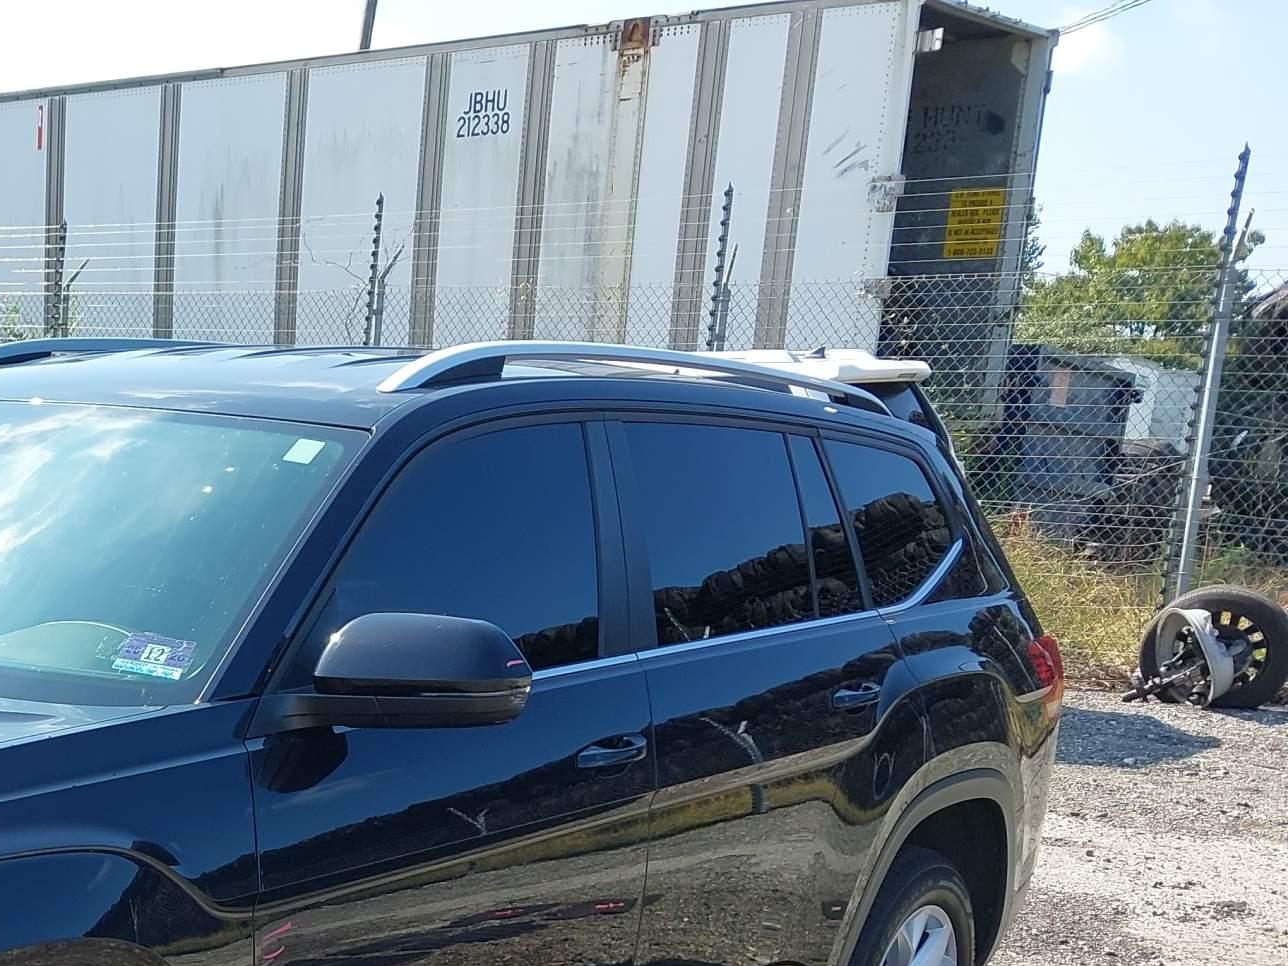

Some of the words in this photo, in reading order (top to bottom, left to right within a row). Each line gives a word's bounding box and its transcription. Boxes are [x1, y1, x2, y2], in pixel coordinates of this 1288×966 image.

[463, 89, 507, 115] JBHU
[456, 112, 510, 138] 212338
[143, 646, 166, 662] 12
